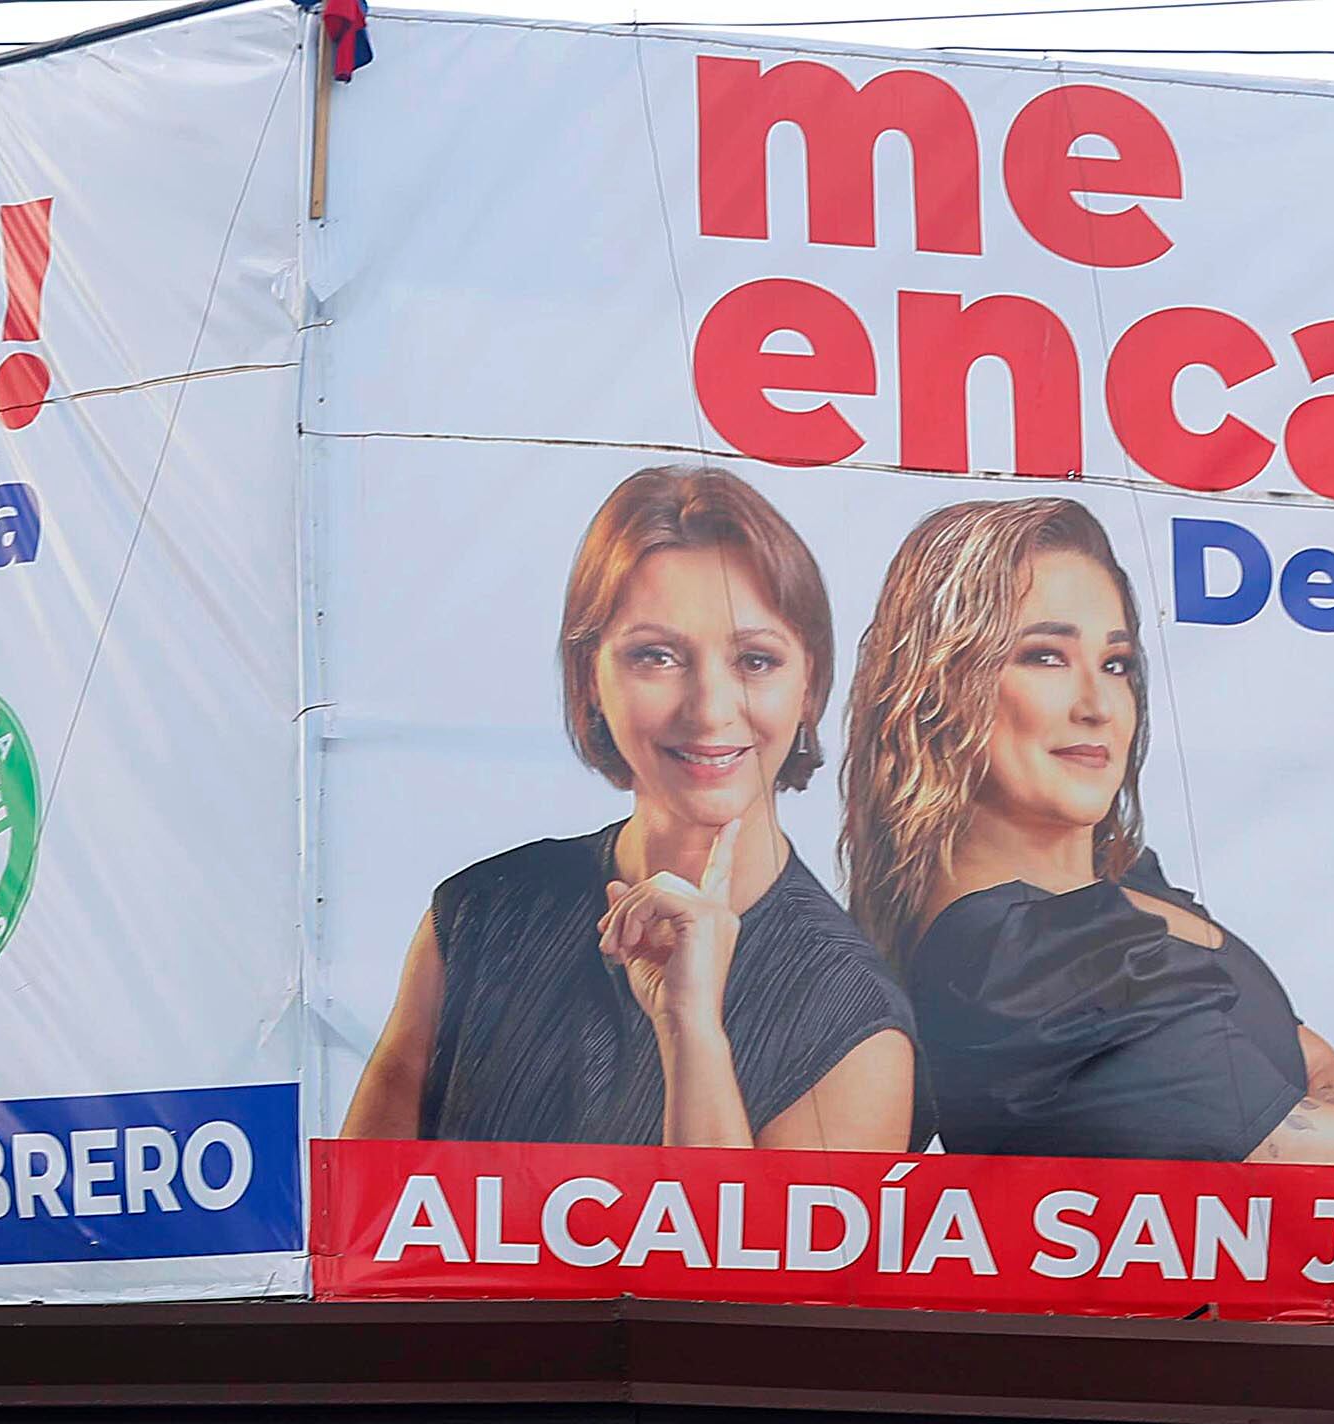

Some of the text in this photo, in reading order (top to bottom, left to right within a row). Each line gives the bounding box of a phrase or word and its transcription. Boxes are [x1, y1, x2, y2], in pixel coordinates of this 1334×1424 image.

[696, 54, 1184, 268] me
[374, 1161, 998, 1276] ALCALDÍA
[1030, 1193, 1270, 1281] SAN
